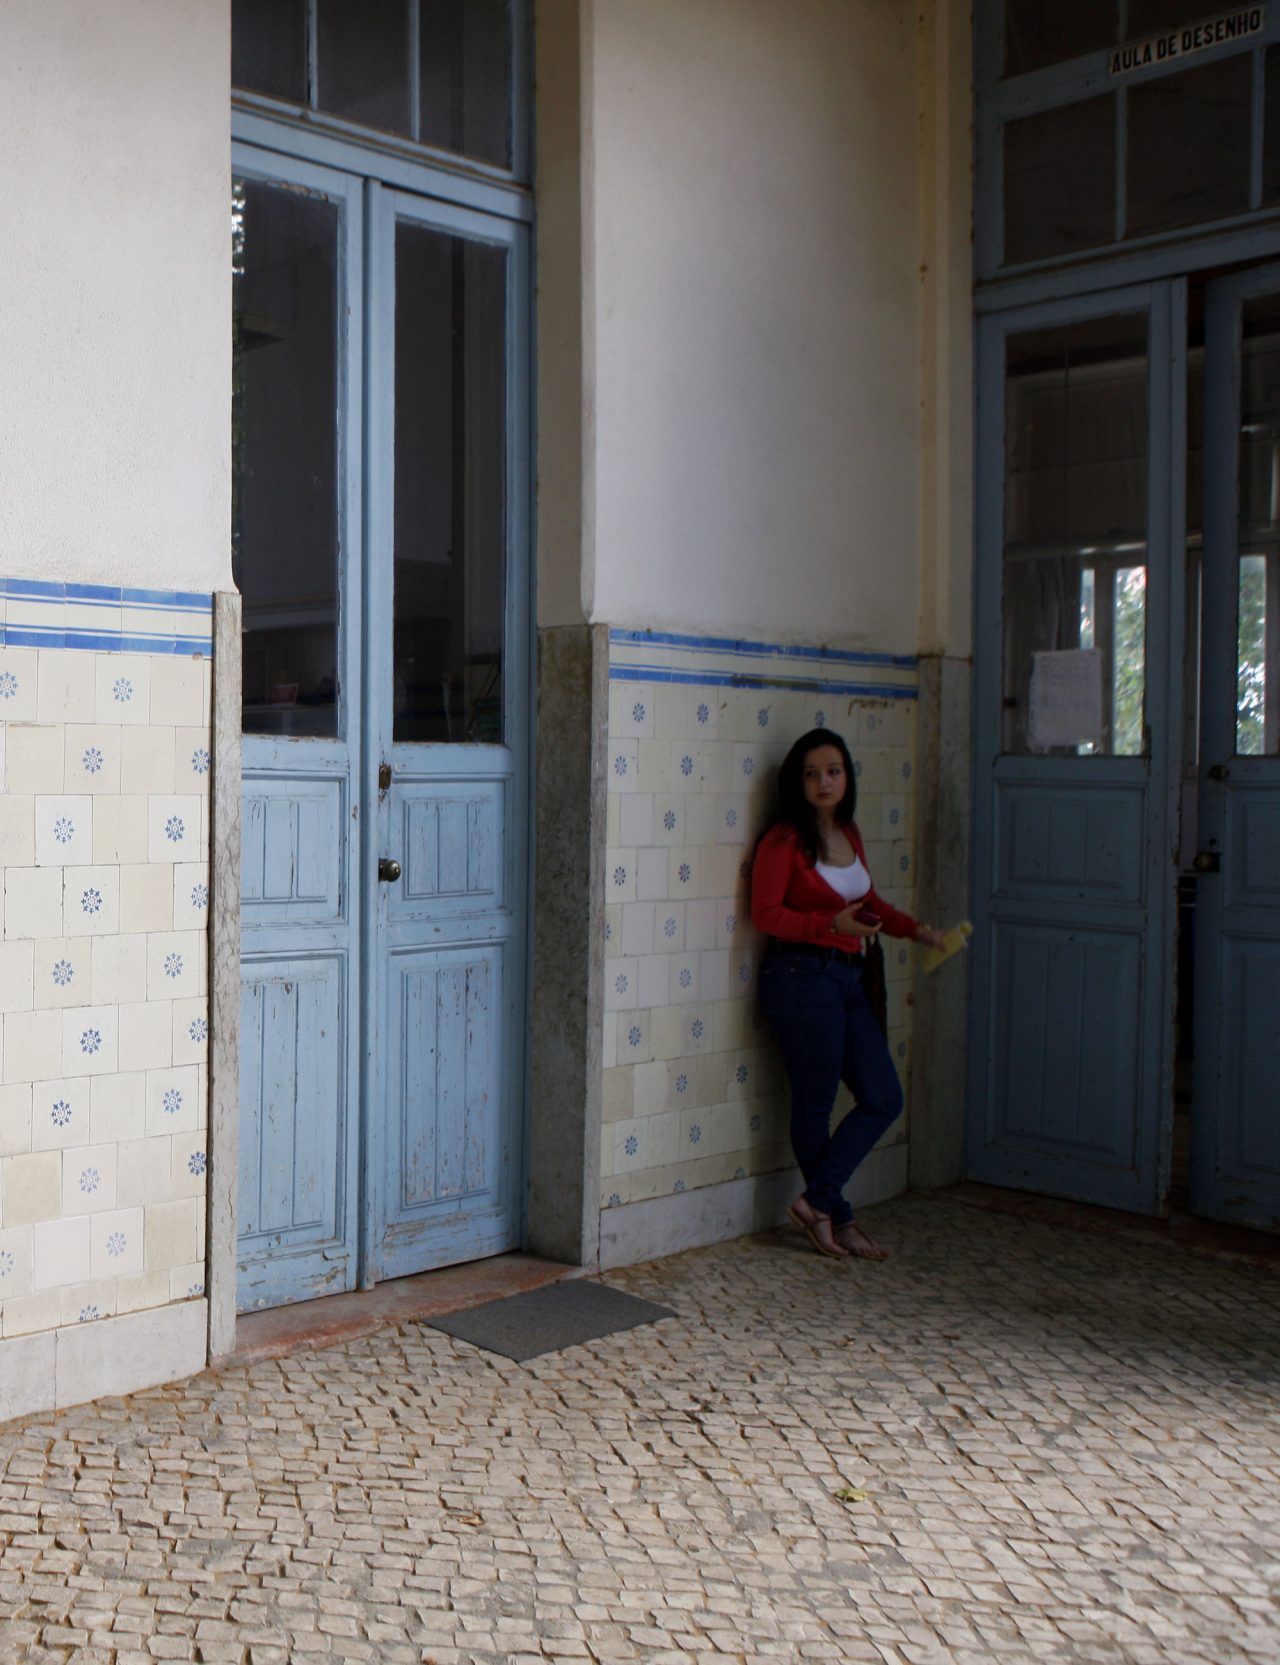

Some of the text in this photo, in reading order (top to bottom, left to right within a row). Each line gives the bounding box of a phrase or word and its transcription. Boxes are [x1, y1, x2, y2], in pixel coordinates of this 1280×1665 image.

[1112, 10, 1261, 74] AULA DE DESENHO
